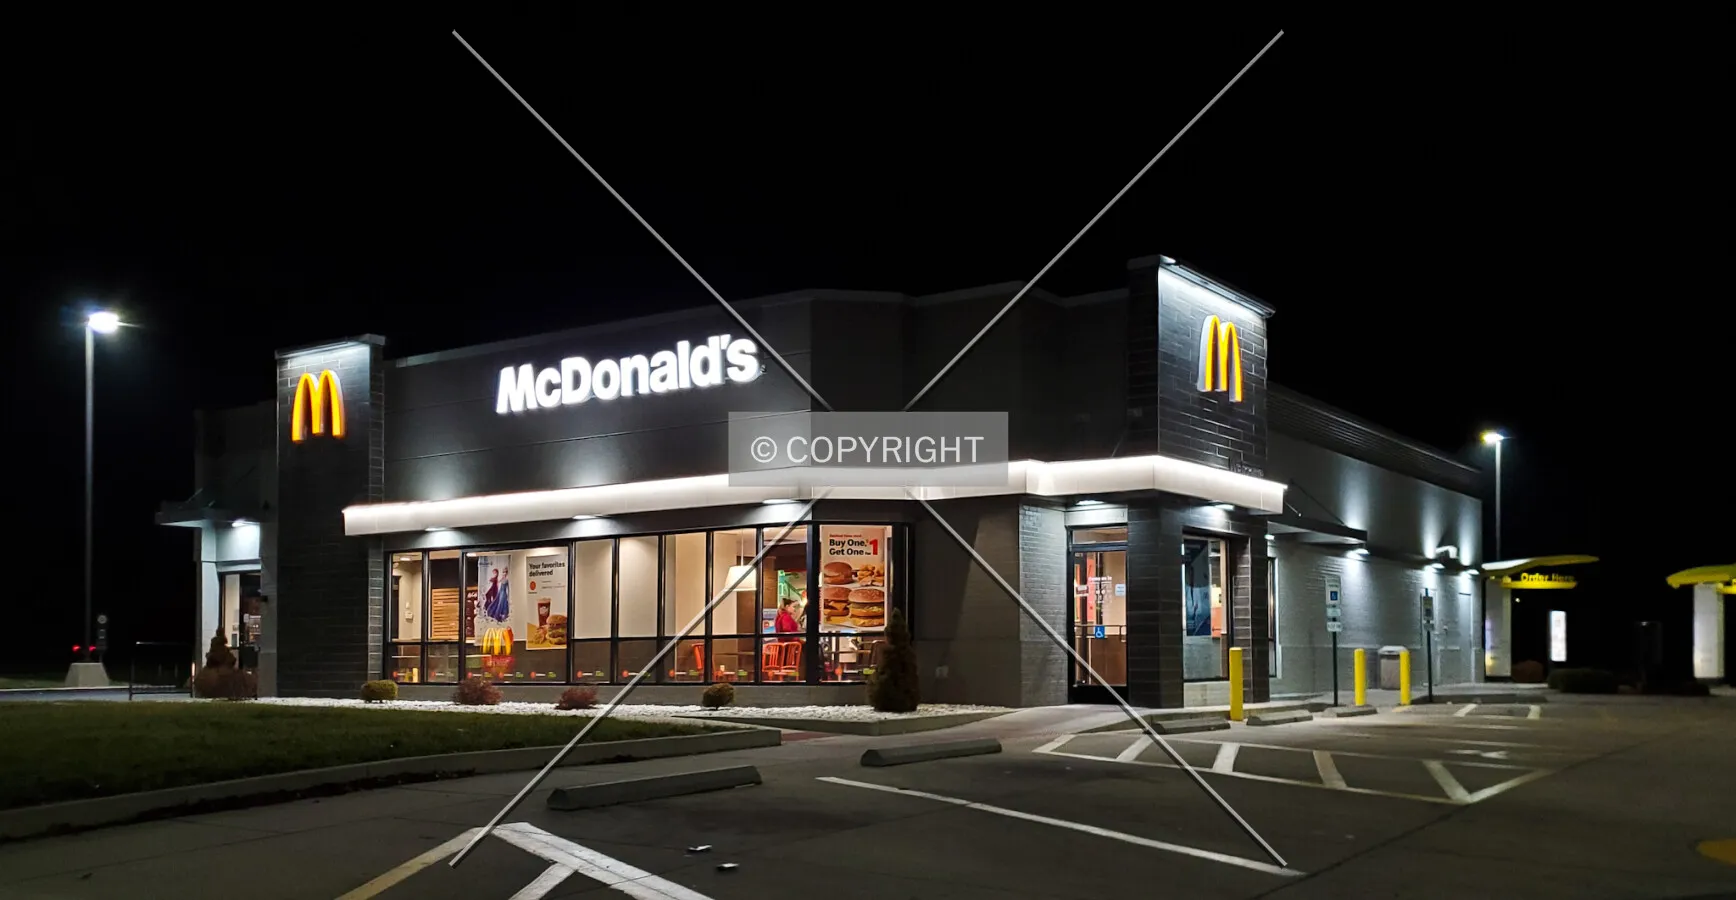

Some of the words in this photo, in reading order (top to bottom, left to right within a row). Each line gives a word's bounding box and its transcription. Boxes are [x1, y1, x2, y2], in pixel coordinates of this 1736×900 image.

[496, 333, 760, 414] McDonald's
[829, 539, 846, 548] Buy
[829, 548, 845, 556] Get
[846, 548, 864, 556] One
[542, 561, 566, 569] favorites
[1521, 572, 1549, 583] Order
